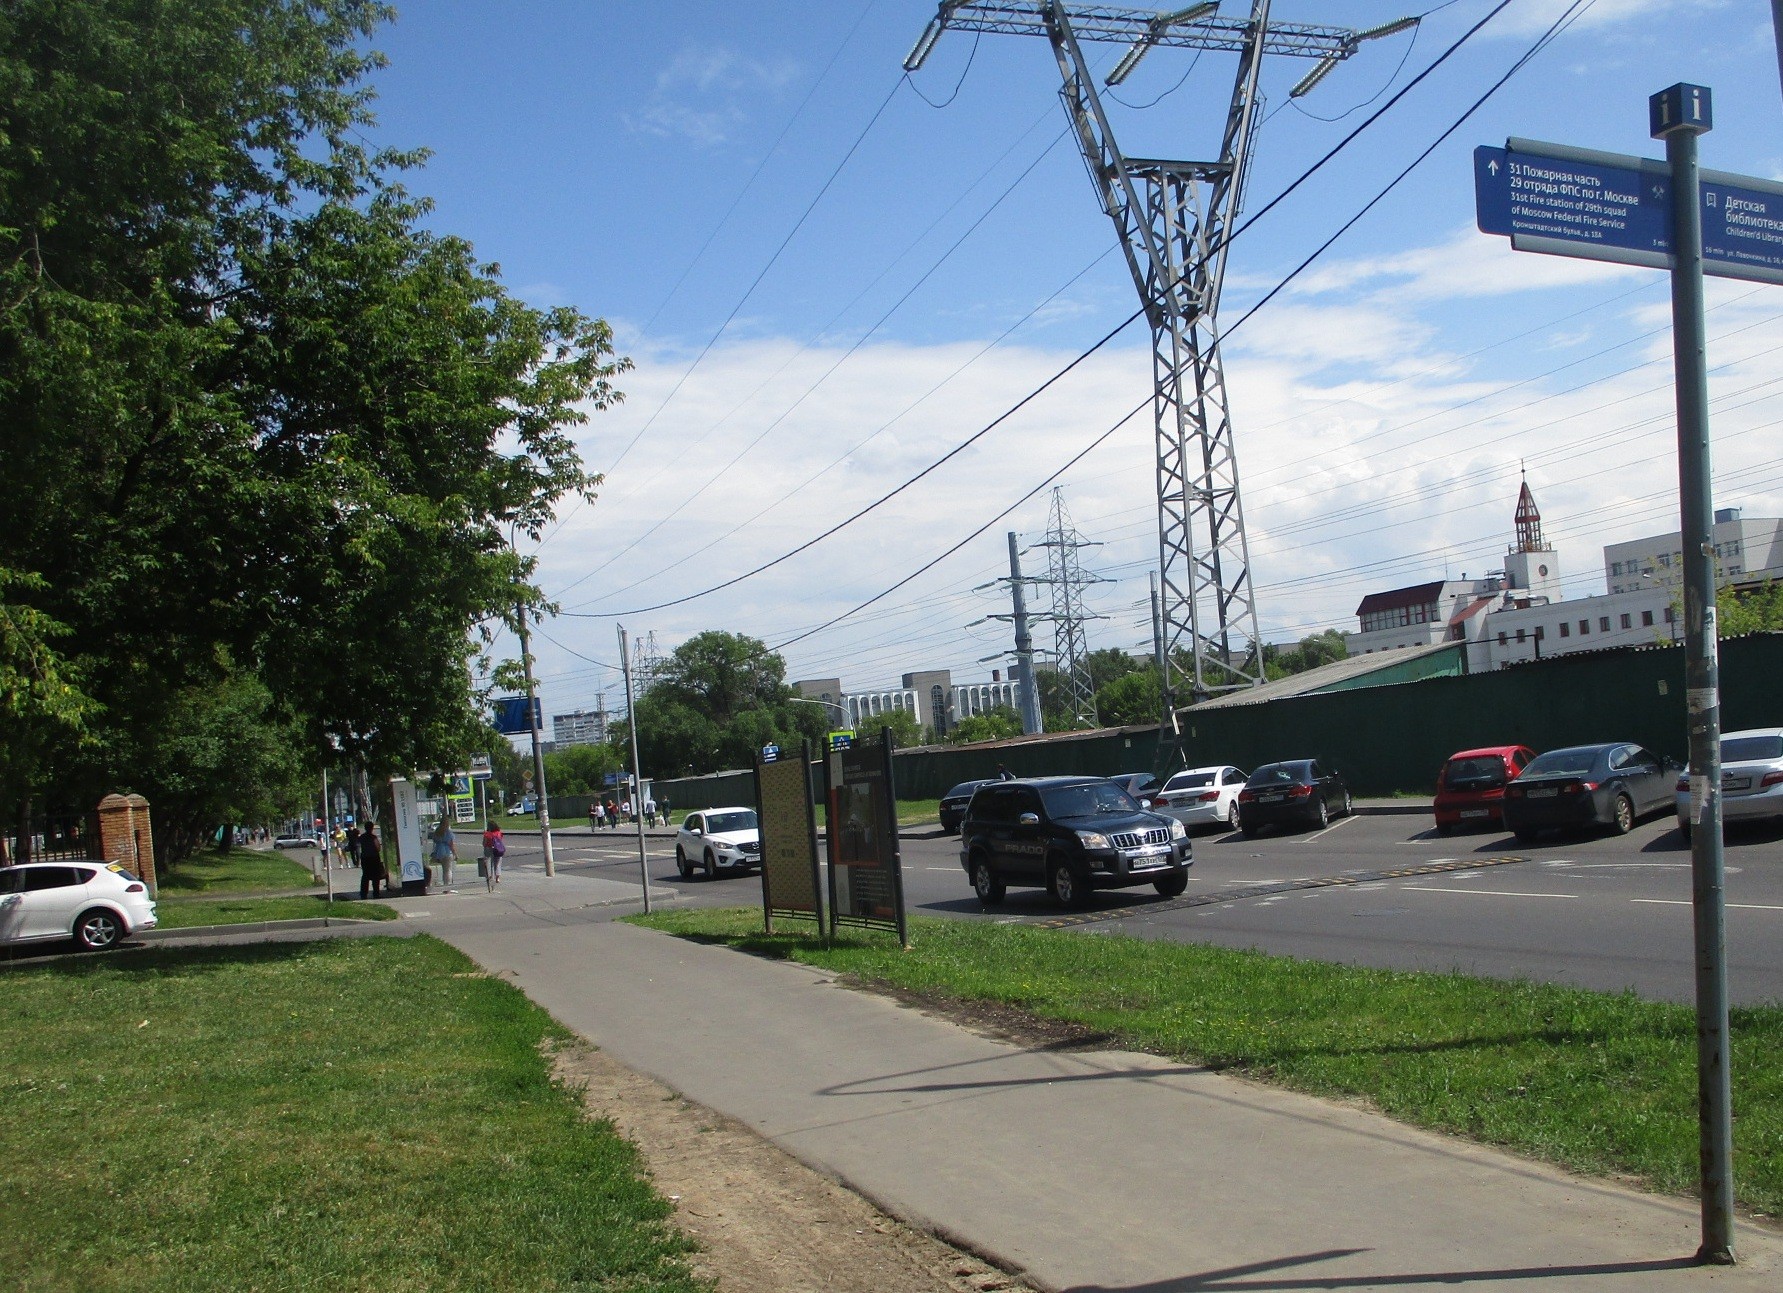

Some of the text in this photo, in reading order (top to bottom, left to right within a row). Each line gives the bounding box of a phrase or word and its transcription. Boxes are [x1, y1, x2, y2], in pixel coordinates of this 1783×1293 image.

[1509, 163, 1600, 186] 31 Пожарная часть
[1510, 177, 1639, 205] 29 отряда ФПС по г. Москве
[1511, 192, 1626, 219] 31st Fire station of 29th squad
[1725, 196, 1765, 213] Детская
[1511, 206, 1625, 230] of Moscow Federal Fire Service
[1512, 220, 1562, 234] Кронштадтский
[1725, 210, 1783, 231] библиотека
[1005, 844, 1043, 855] PRADO
